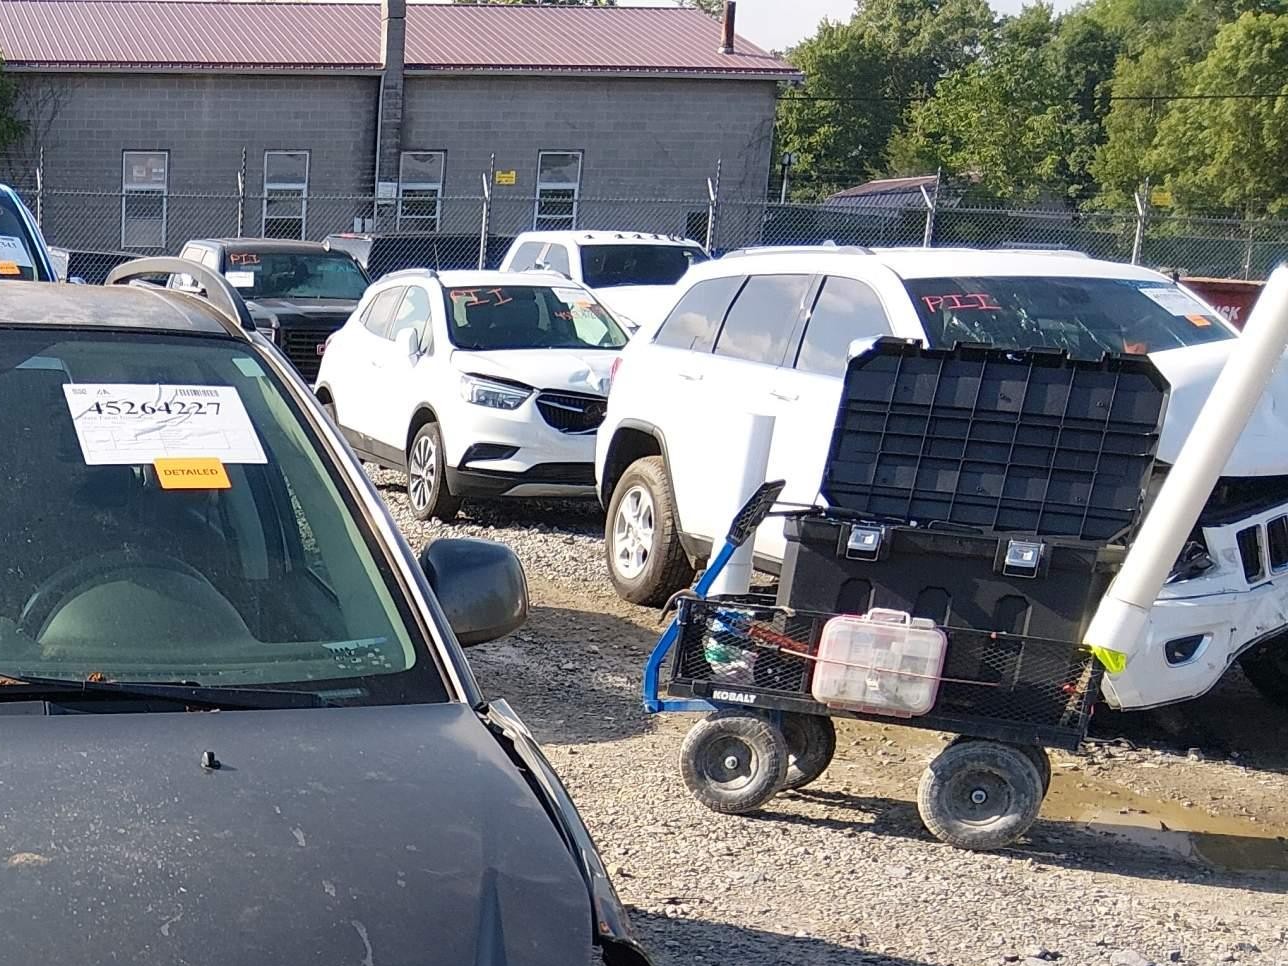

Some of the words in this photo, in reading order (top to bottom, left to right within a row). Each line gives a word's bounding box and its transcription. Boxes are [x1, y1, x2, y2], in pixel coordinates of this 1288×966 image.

[920, 293, 1003, 313] PII
[88, 400, 221, 416] 45264227
[163, 468, 219, 477] DETAILED
[712, 690, 757, 704] KOBALT
